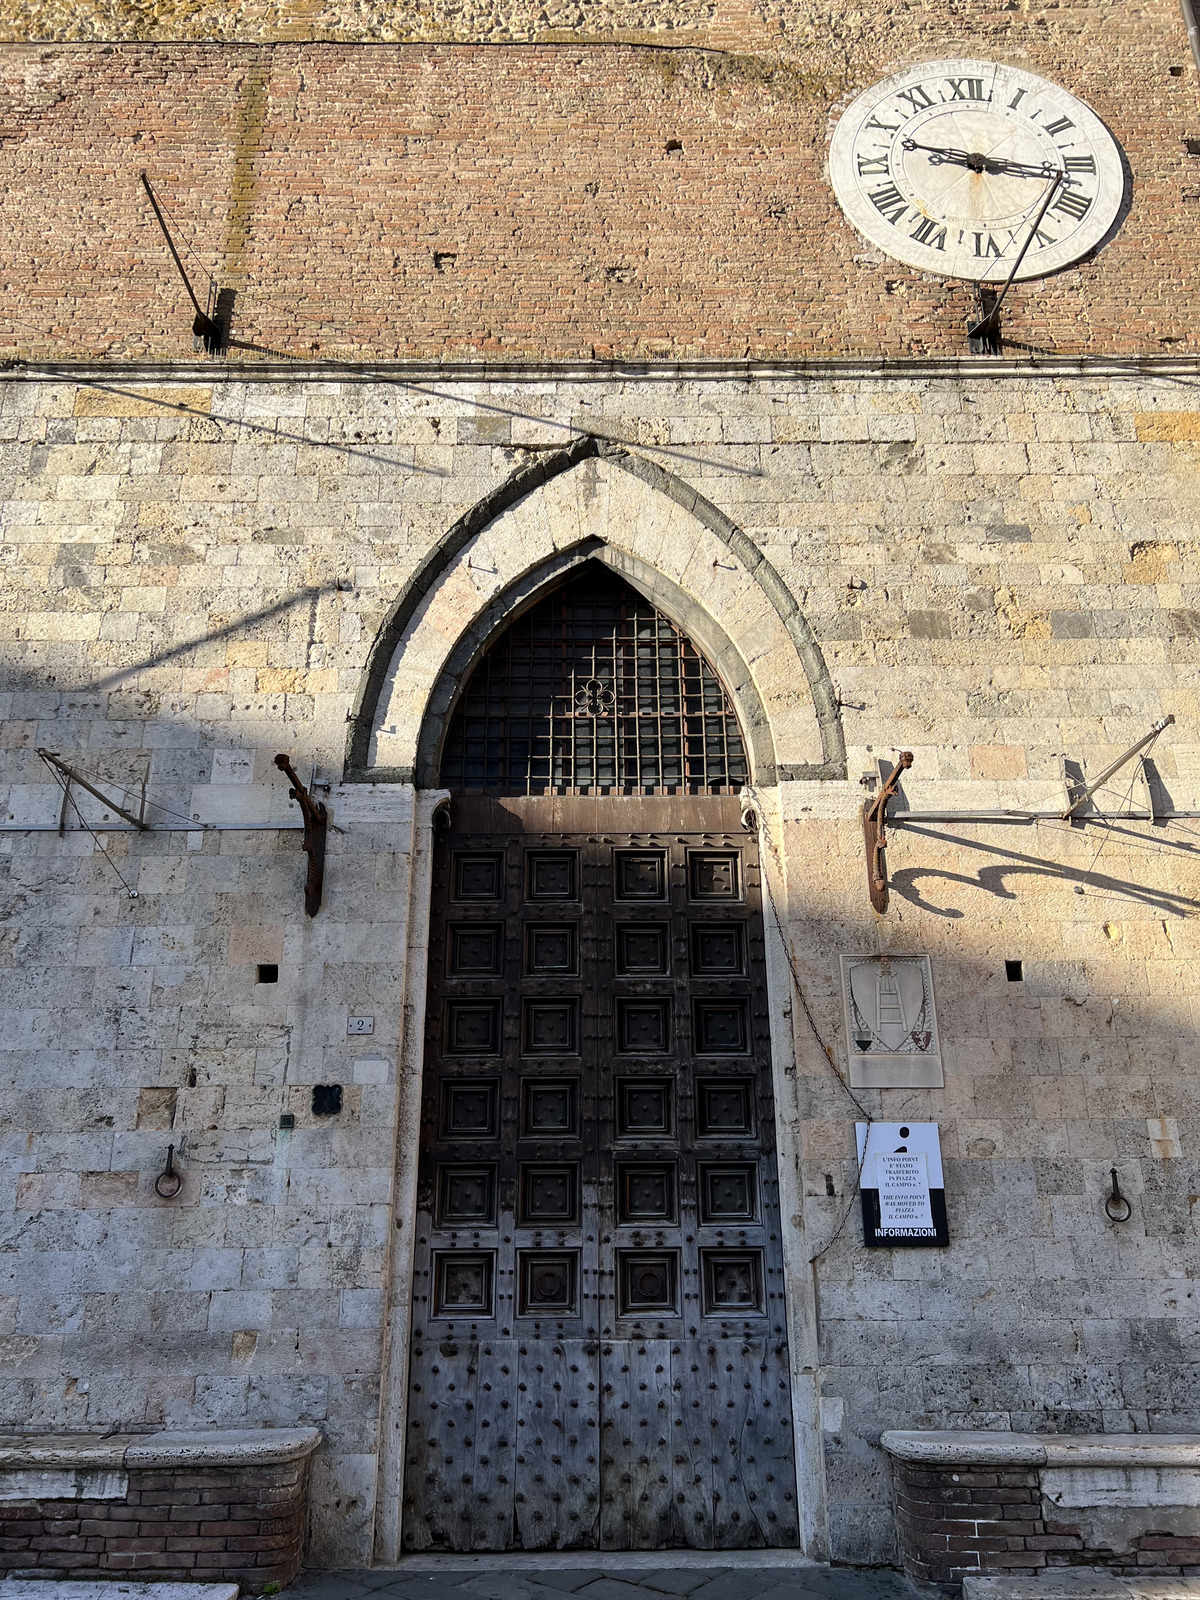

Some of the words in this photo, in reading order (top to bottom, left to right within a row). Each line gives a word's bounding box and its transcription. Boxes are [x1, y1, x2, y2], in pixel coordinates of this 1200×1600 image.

[896, 85, 937, 114] XI
[943, 77, 985, 101] XII
[865, 115, 900, 139] X
[1042, 115, 1076, 137] II
[1062, 154, 1096, 175] III
[867, 184, 910, 226] VIII
[1051, 188, 1093, 221] IIII
[909, 216, 947, 251] VII
[1030, 222, 1058, 248] V
[357, 1019, 365, 1031] 2
[875, 1228, 937, 1237] INFORMAZIONI
